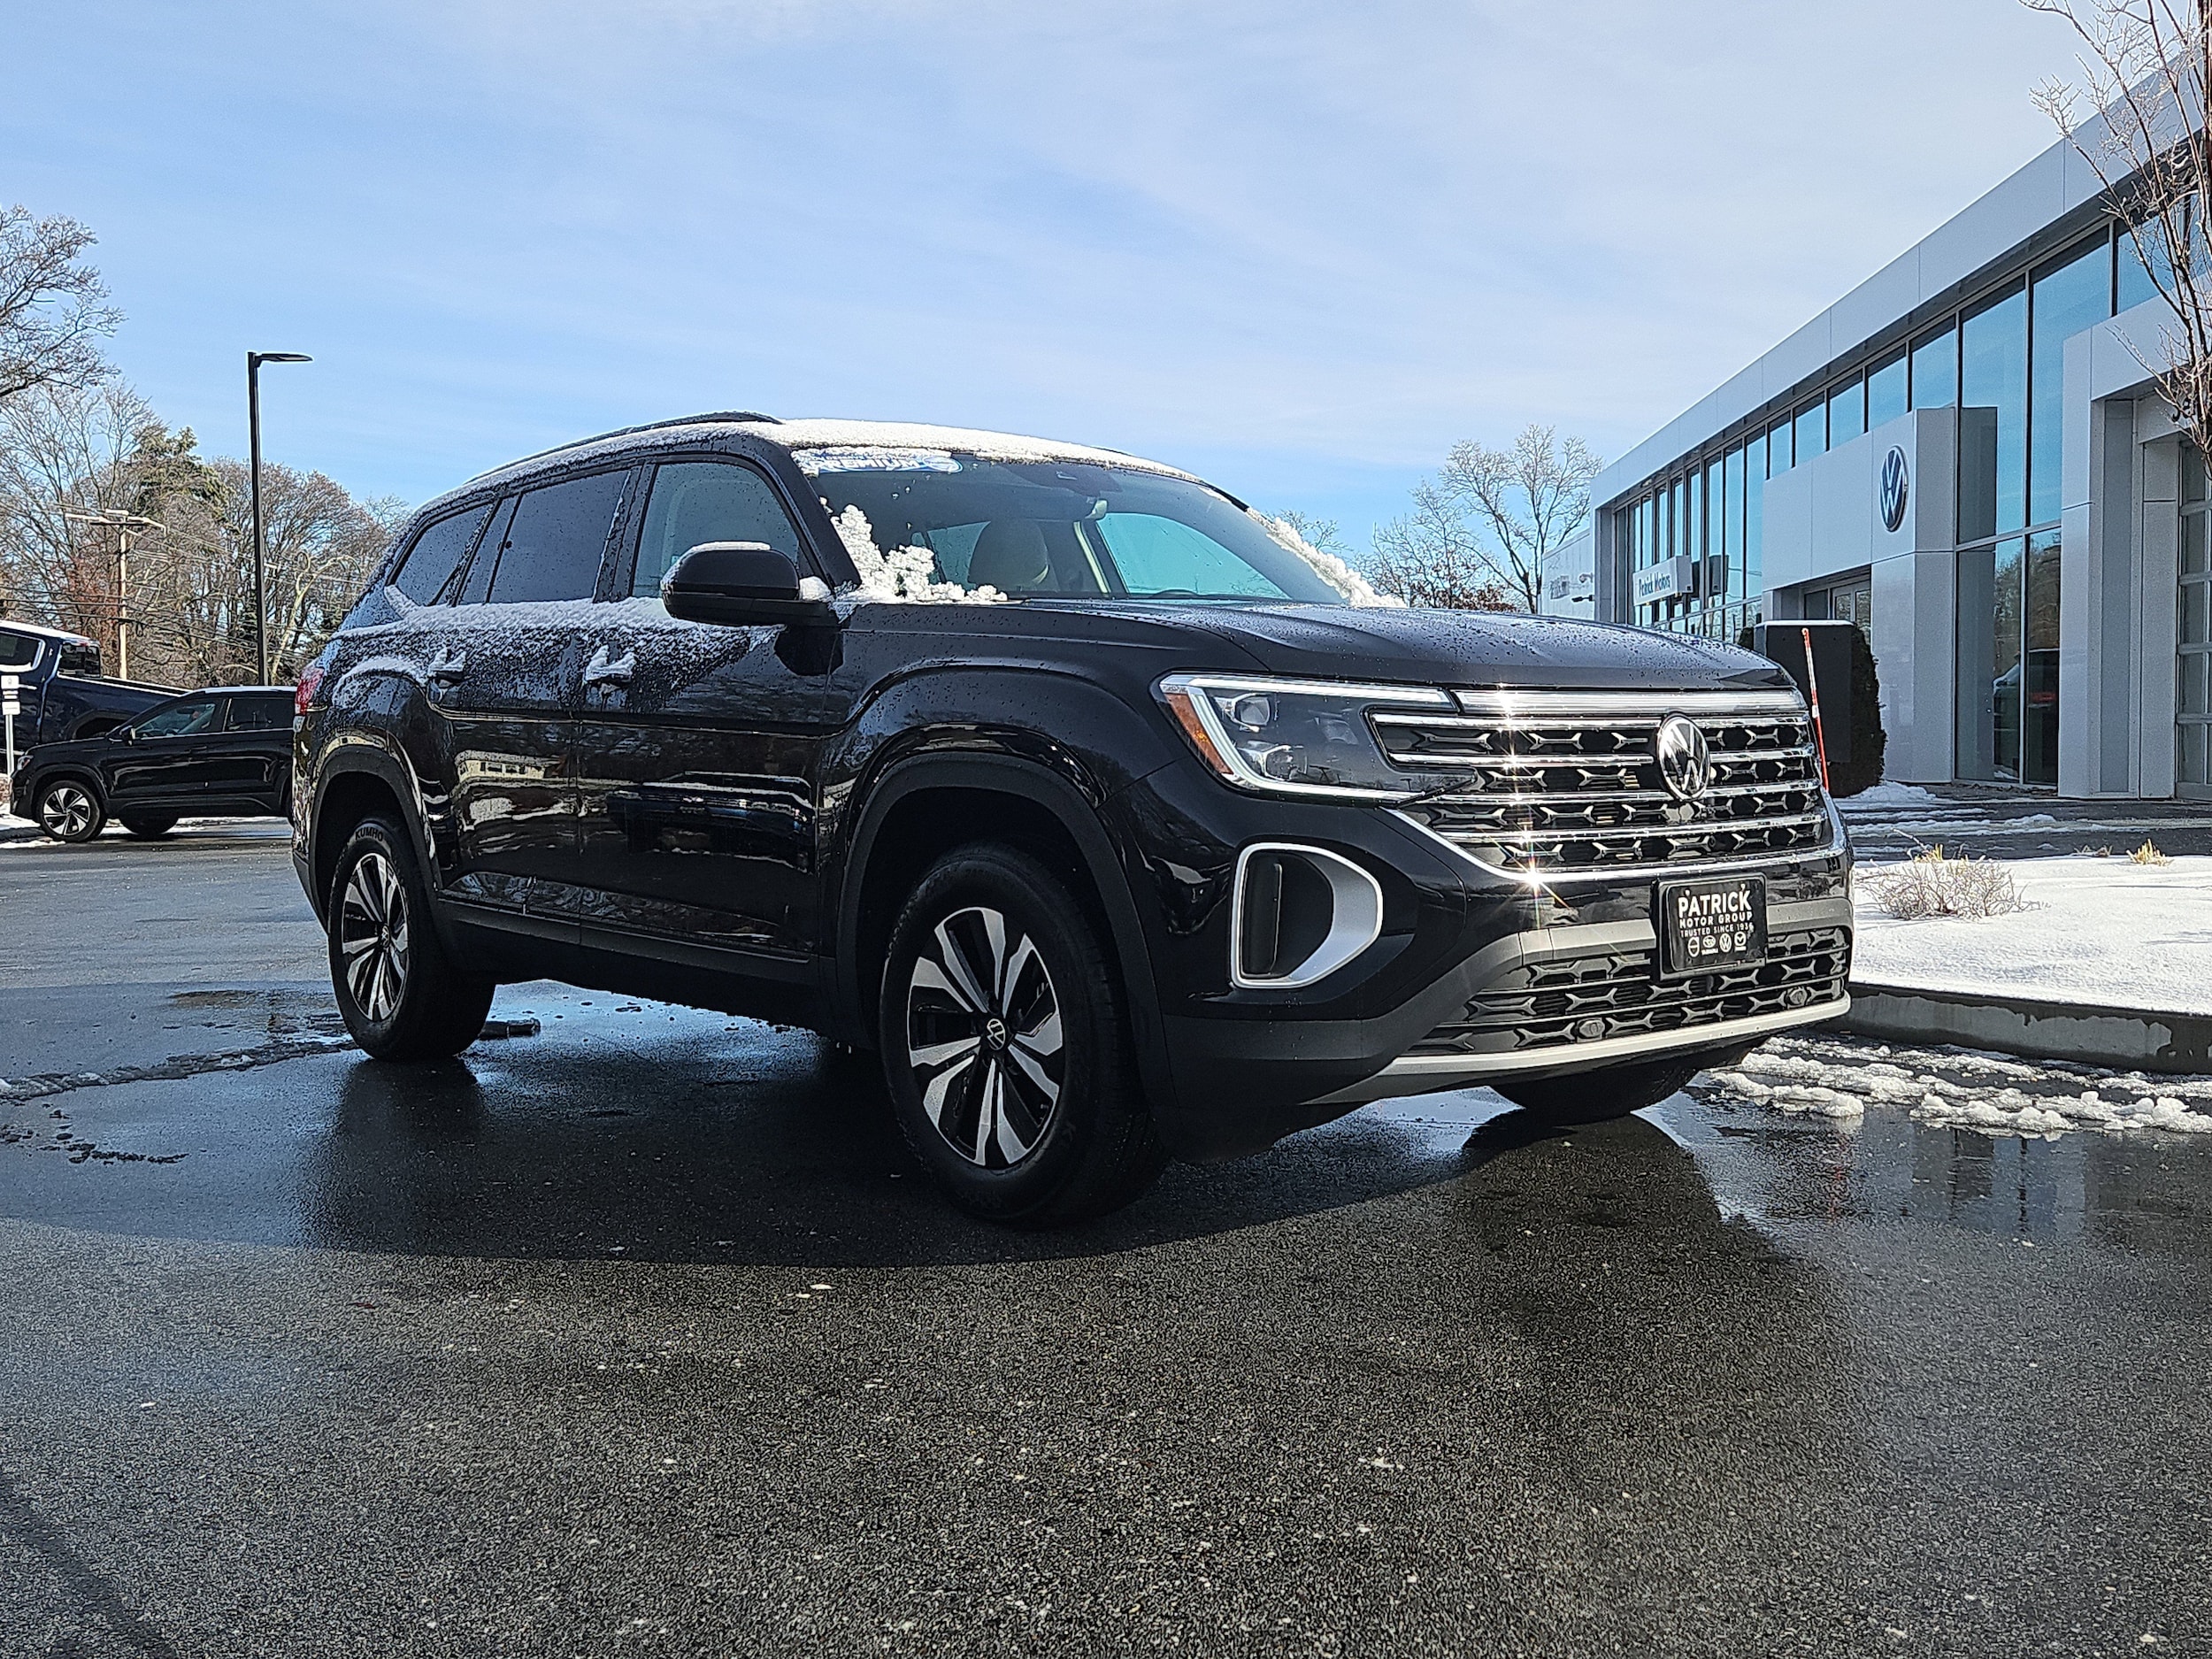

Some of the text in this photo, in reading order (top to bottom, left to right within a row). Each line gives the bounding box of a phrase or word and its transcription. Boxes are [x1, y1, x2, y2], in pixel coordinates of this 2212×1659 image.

[355, 826, 383, 841] KUMHO
[1678, 890, 1752, 918] PATRICK
[1679, 911, 1753, 929] MOTOR GROUP
[1680, 926, 1711, 938] TRUSTED
[1713, 924, 1735, 934] SINCE
